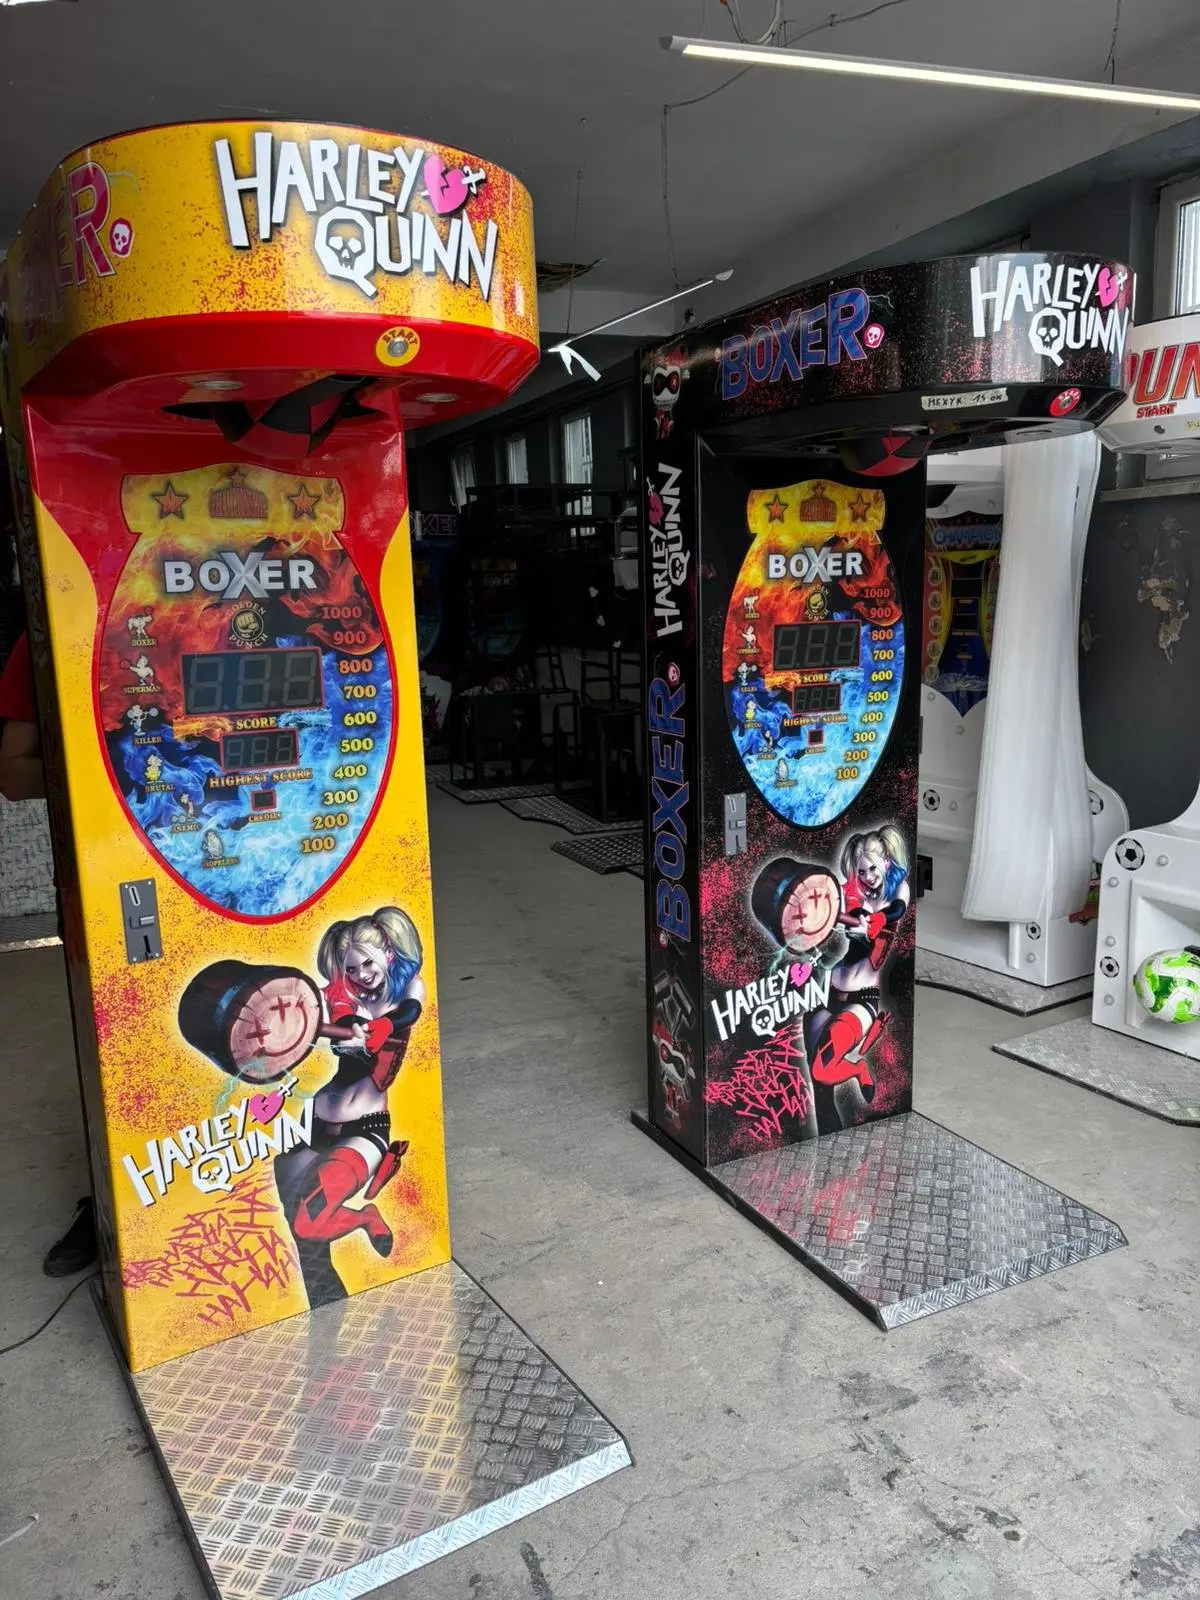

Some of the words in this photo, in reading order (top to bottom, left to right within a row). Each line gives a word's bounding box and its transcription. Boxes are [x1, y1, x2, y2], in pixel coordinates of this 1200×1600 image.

[214, 131, 424, 249] HARLEY
[314, 205, 499, 300] QUINN
[970, 260, 1101, 338] HARLEY
[382, 328, 419, 345] START
[1028, 302, 1130, 368] QUINN
[720, 287, 869, 400] BOXER
[1136, 403, 1177, 419] START
[658, 462, 691, 587] QUINN
[768, 547, 864, 584] BOXER
[164, 551, 318, 599] BOXER
[649, 524, 683, 638] HARLEY
[863, 589, 890, 599] 1000
[321, 605, 362, 620] 1000
[870, 607, 892, 618] 900
[229, 632, 269, 649] PUNCH
[333, 630, 367, 645] 900
[872, 629, 894, 641] 800
[873, 650, 894, 662] 700
[339, 658, 373, 675] 800
[803, 673, 830, 683] SCORE
[871, 670, 893, 682] 600
[343, 685, 377, 700] 700
[867, 691, 889, 703] 500
[236, 717, 278, 731] SCORE
[344, 711, 377, 727] 600
[783, 717, 821, 728] HIGHEST
[861, 711, 884, 723] 400
[341, 737, 374, 753] 500
[853, 731, 876, 743] 300
[844, 750, 868, 762] 200
[209, 773, 268, 789] HIGHEST
[271, 767, 314, 783] SCORE
[333, 764, 368, 780] 400
[836, 768, 859, 780] 100
[145, 783, 175, 794] BRUTAL
[323, 789, 359, 806] 300
[649, 677, 692, 943] BOXER
[171, 823, 203, 834] ANEMIC
[312, 813, 348, 830] 200
[301, 836, 336, 853] 100
[711, 965, 790, 1042] HARLEY
[751, 970, 832, 1038] QUINN
[122, 1097, 249, 1208] HARLEY
[192, 1098, 316, 1194] QUINN
